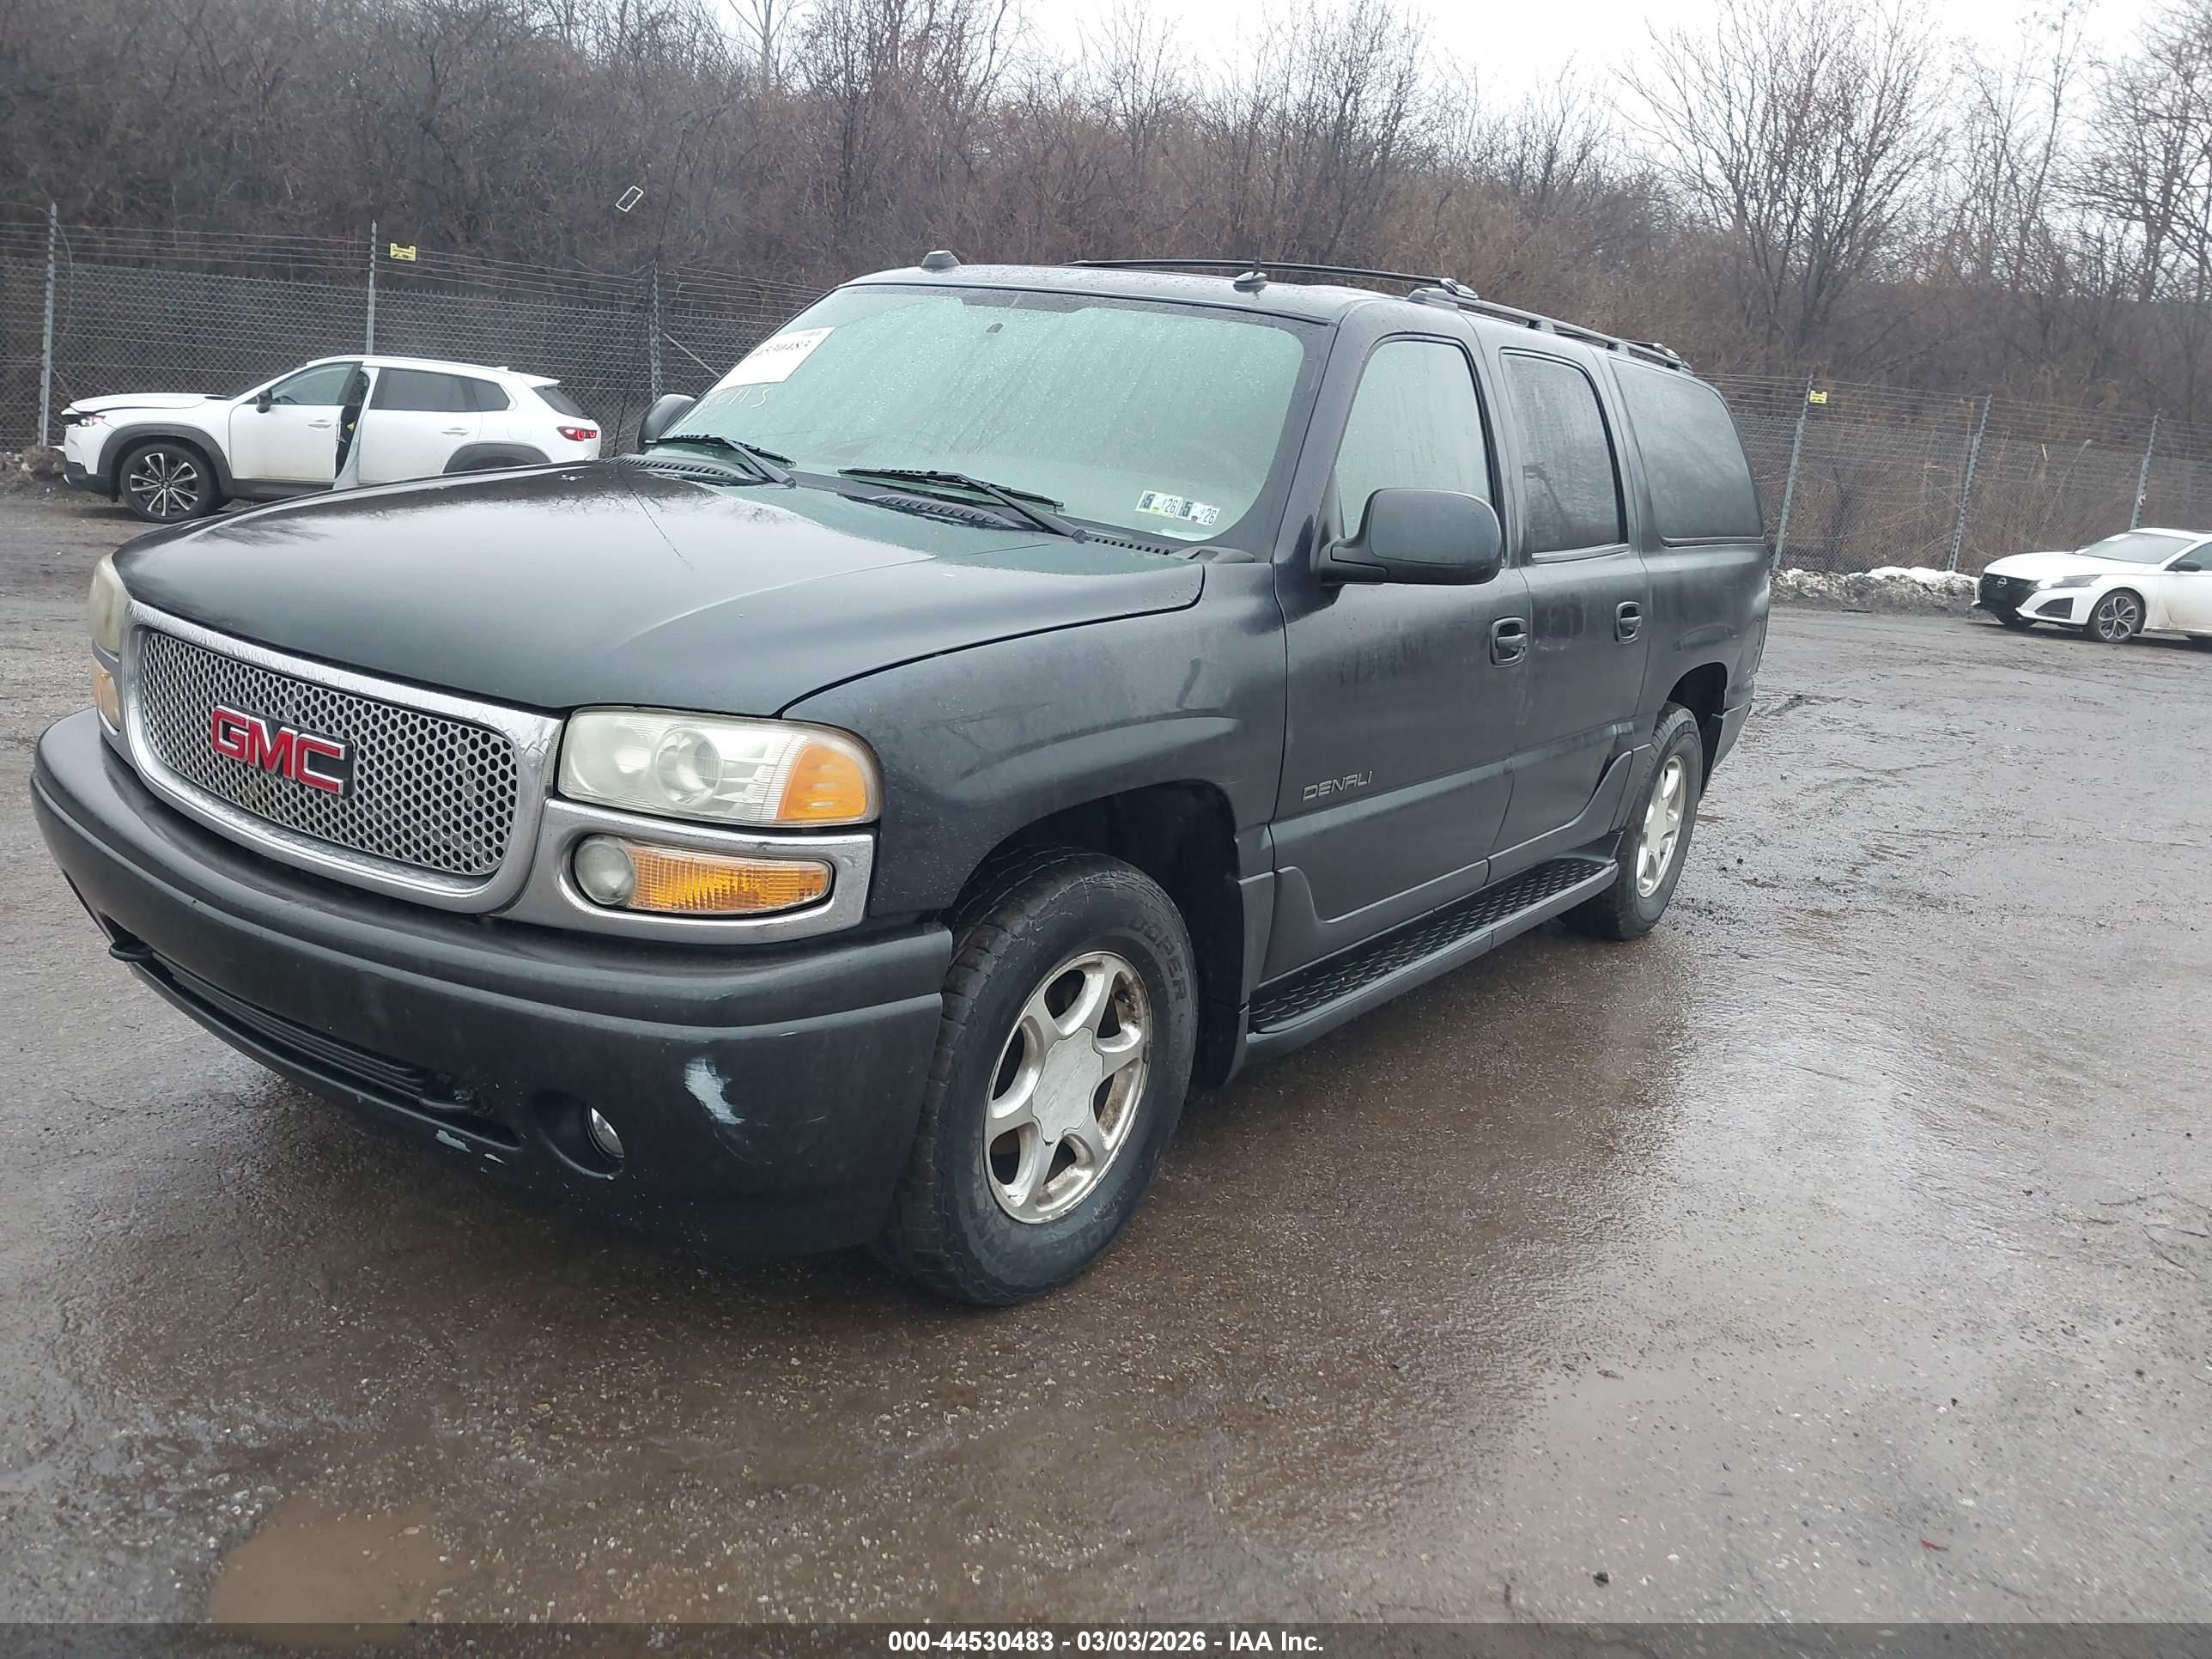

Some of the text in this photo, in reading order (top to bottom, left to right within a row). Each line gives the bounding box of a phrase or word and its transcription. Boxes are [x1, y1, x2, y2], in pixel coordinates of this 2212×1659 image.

[1164, 498, 1178, 514] 26
[1204, 507, 1217, 524] 26
[211, 704, 346, 796] GMC
[1302, 770, 1373, 802] DENALI
